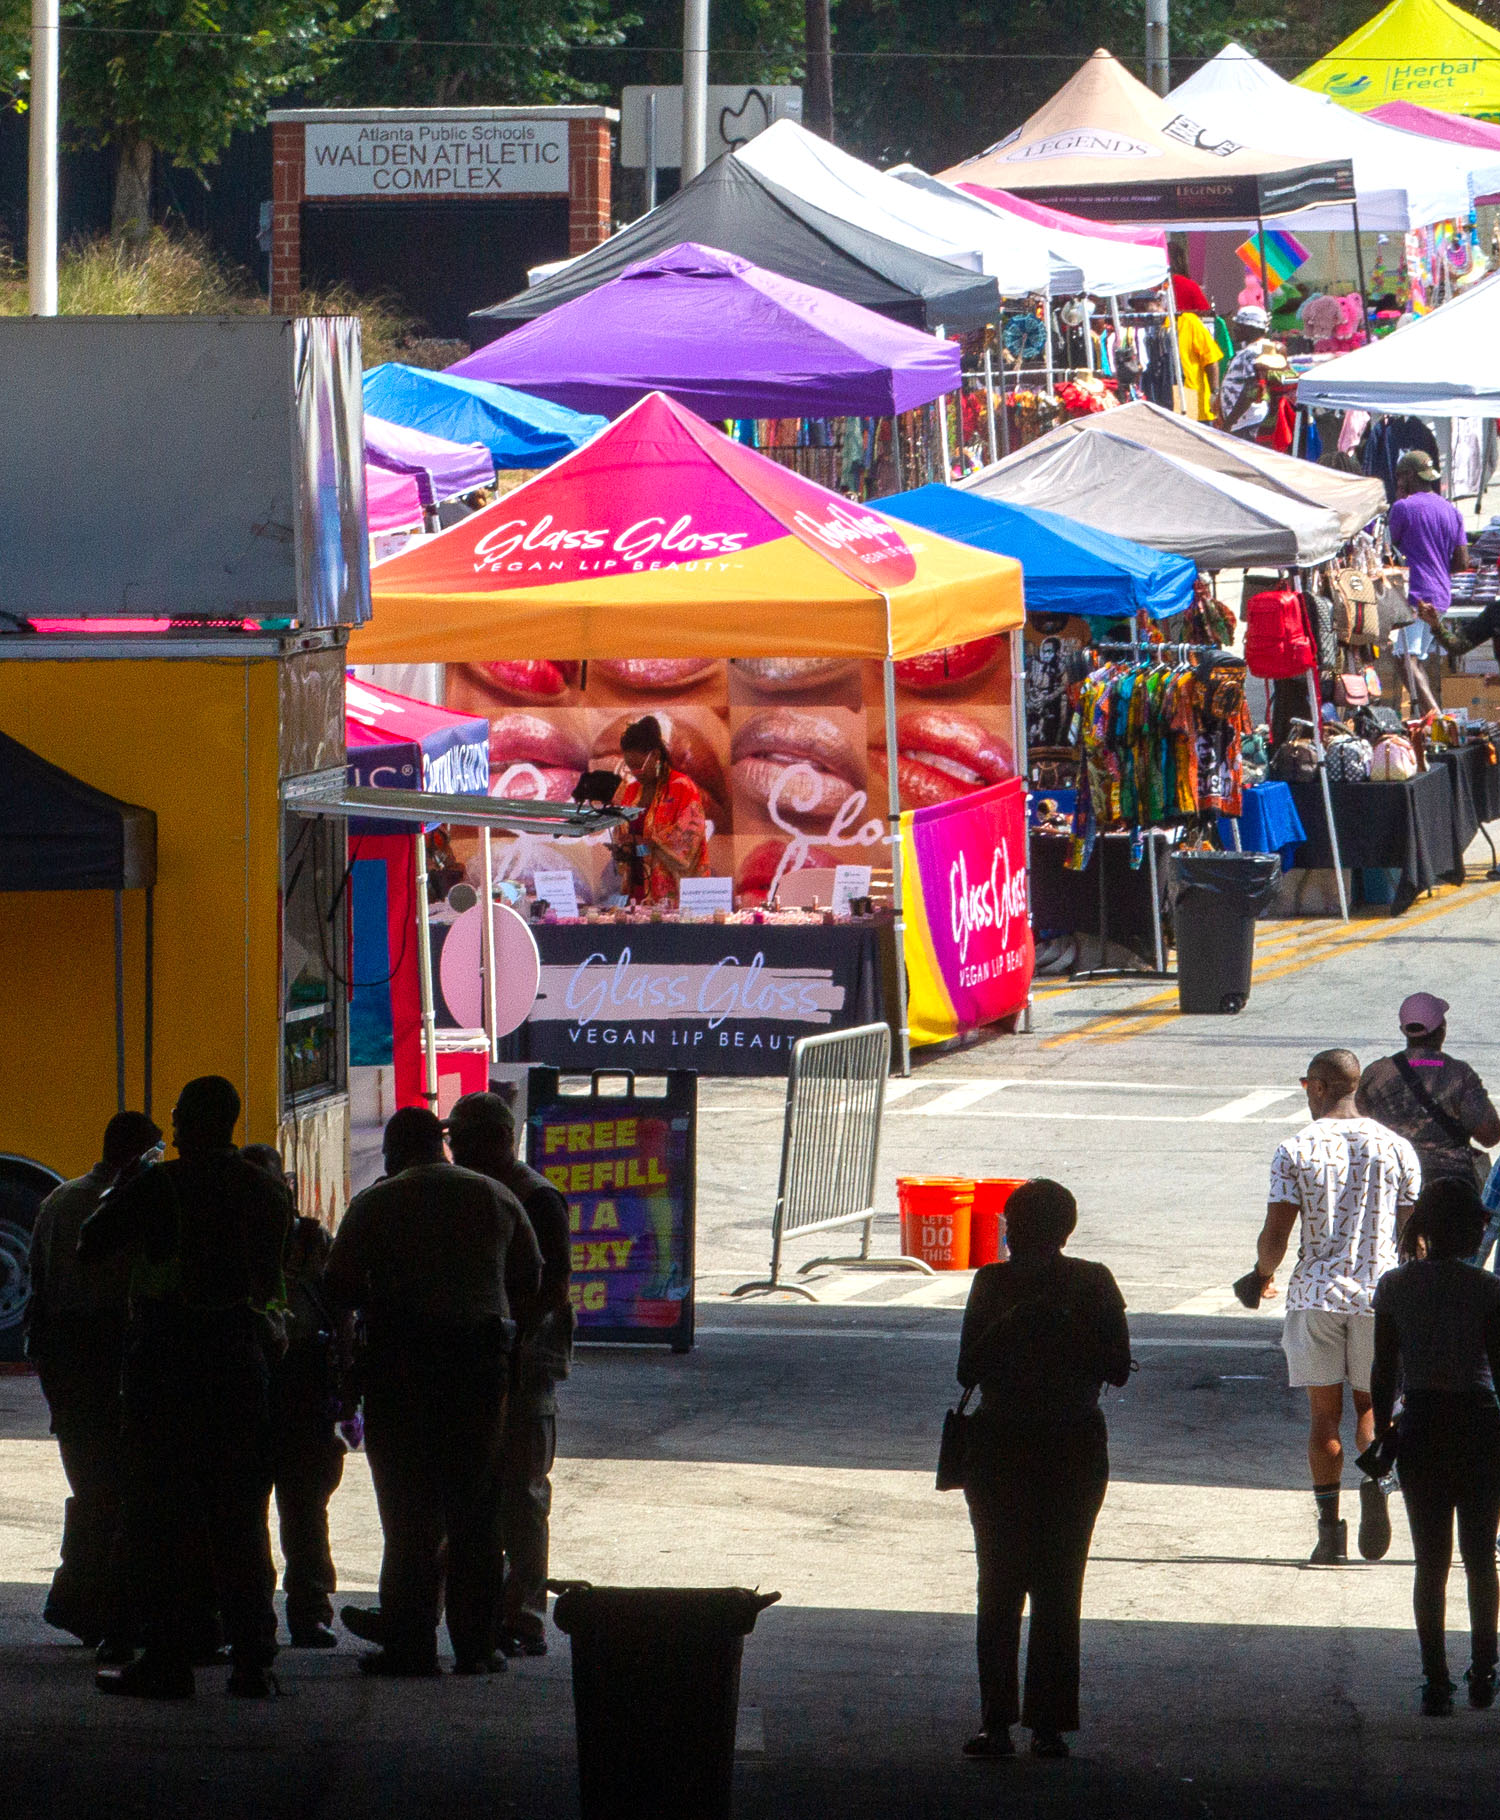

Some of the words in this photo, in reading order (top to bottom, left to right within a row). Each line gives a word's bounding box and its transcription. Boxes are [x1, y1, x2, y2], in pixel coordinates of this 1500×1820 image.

[1394, 57, 1479, 78] Herbal
[1392, 76, 1455, 91] Erect
[358, 128, 413, 142] Atlanta
[419, 127, 467, 141] Public
[472, 126, 535, 140] Schools
[314, 144, 427, 166] WALDEN
[433, 143, 560, 164] ATHLETIC
[1022, 135, 1148, 158] LEGENDS
[373, 168, 502, 189] COMPLEX
[474, 515, 609, 563] Glass
[613, 515, 748, 561] Gloss
[473, 561, 564, 573] VEGAN
[579, 561, 616, 571] LIP
[633, 561, 733, 573] BEAUTY
[950, 849, 993, 965] Glass
[990, 837, 1027, 950] Gloss
[959, 962, 989, 988] VEGAN
[992, 957, 1004, 978] LIP
[565, 946, 689, 1026] Glass
[697, 951, 822, 1029] Gloss
[568, 1029, 656, 1044] VEGAN
[671, 1030, 704, 1046] LIP
[719, 1032, 796, 1050] BEAUT
[545, 1119, 637, 1153] FREE
[543, 1157, 668, 1193] REFILL
[592, 1200, 619, 1231] A
[921, 1214, 953, 1224] LET'S
[921, 1226, 953, 1246] DO
[570, 1240, 633, 1272] EXY
[921, 1248, 955, 1261] THIS.
[569, 1280, 606, 1313] EG
